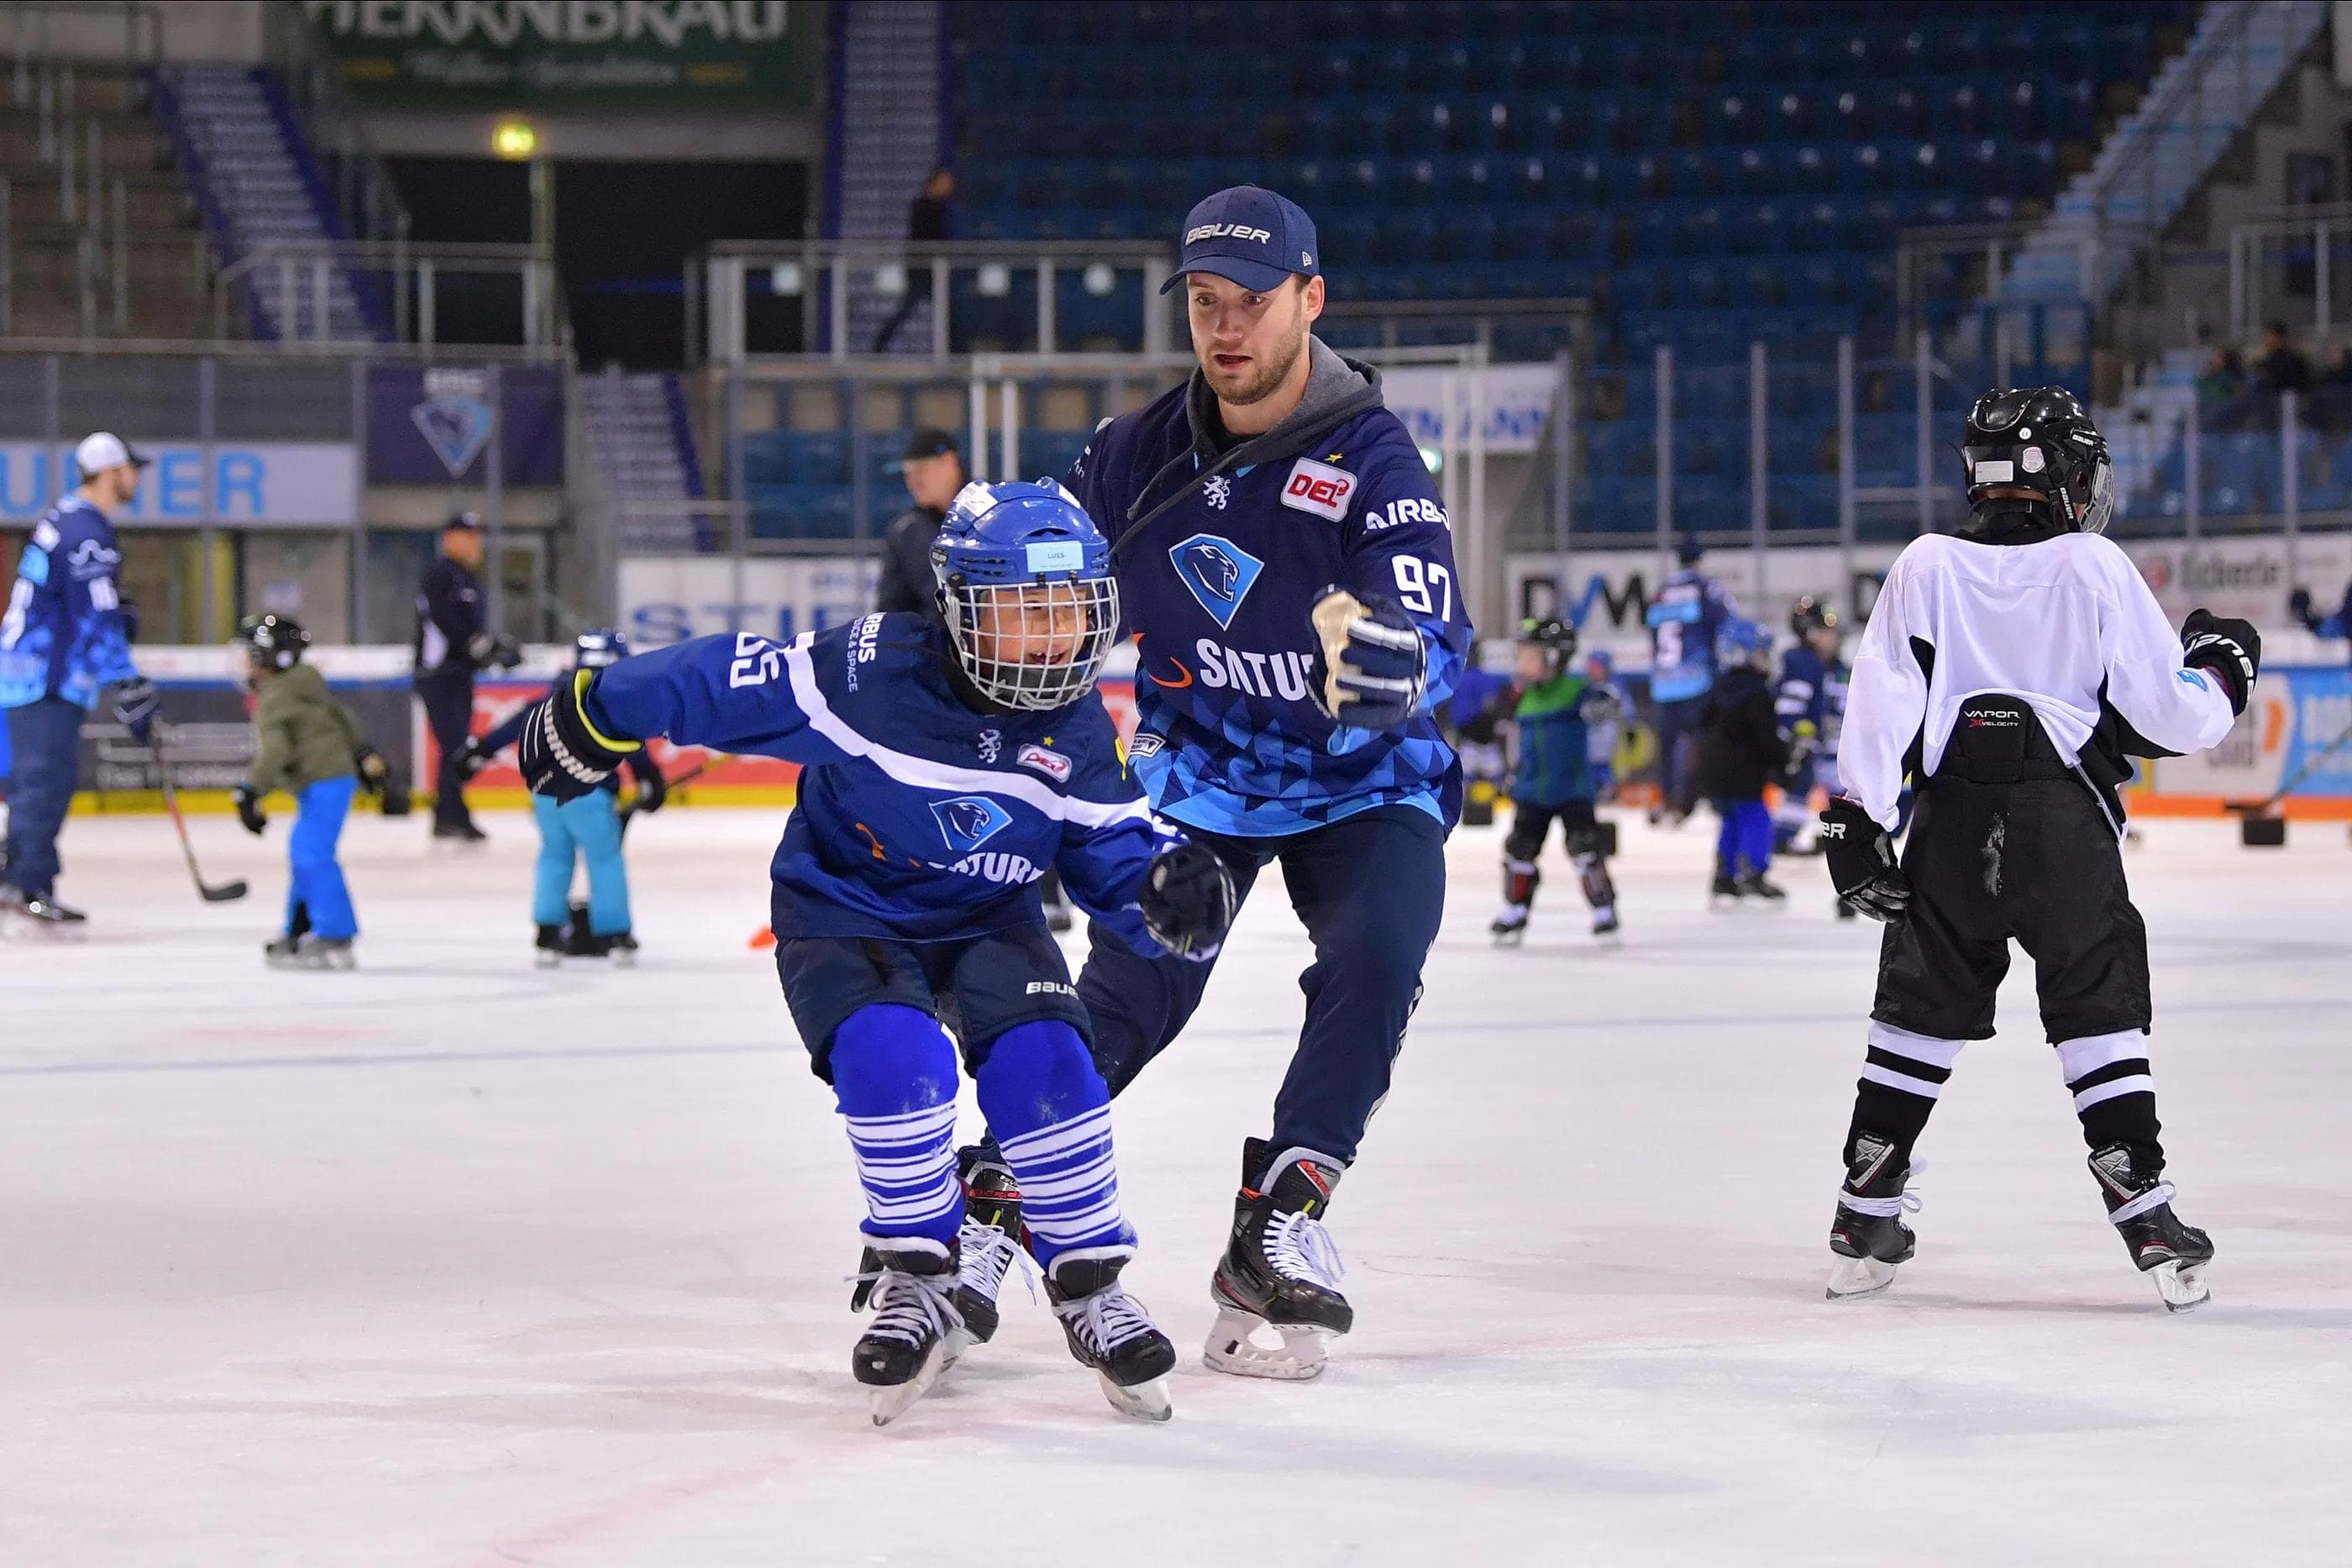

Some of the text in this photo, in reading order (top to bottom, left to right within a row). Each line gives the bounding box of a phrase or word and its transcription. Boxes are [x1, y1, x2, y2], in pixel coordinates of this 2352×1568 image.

[1185, 223, 1271, 246] BAUER
[1391, 554, 1452, 623] 97
[847, 649, 858, 693] SPACE
[1964, 711, 2020, 719] VAPOR
